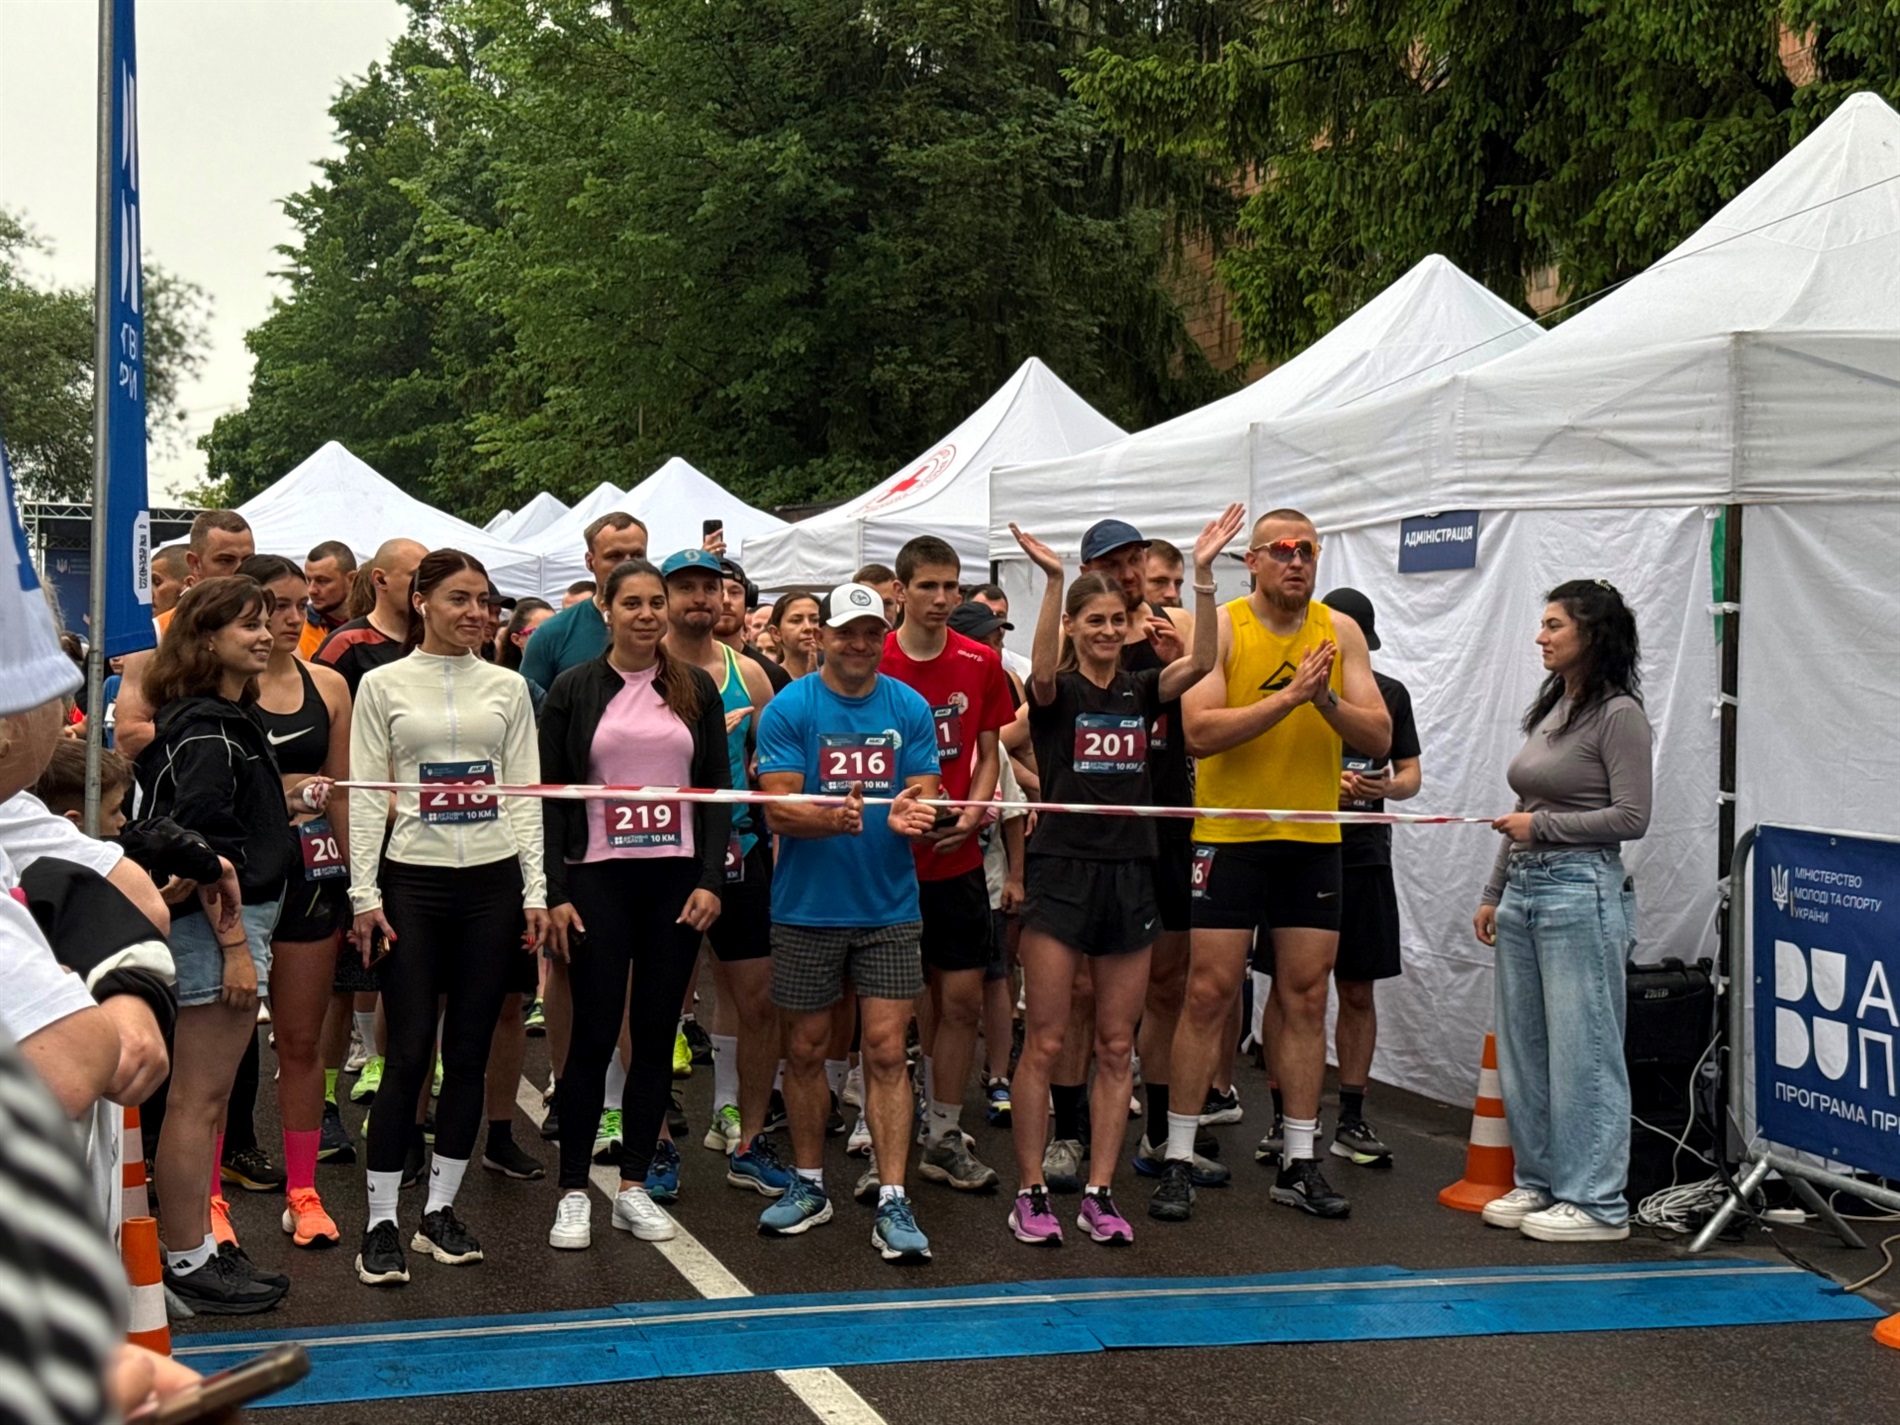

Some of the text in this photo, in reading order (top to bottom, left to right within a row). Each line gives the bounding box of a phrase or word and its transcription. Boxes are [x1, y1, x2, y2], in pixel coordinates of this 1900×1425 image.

[1404, 525, 1474, 547] АДМІНІСТРАЦІЯ
[1084, 733, 1135, 757] 201
[829, 751, 886, 775] 216
[1116, 762, 1126, 770] 10
[864, 781, 874, 789] 10
[466, 811, 477, 820] 10
[615, 804, 672, 830] 219
[310, 836, 343, 862] 20
[650, 834, 661, 843] 10
[1794, 866, 1863, 889] МІНІСТЕРСТВО
[1793, 886, 1882, 913] МОЛОДІ ТА СПОРТУ
[1793, 906, 1830, 924] УКРАЇНИ
[1775, 1081, 1900, 1135] ПРОГРАМА ПР
